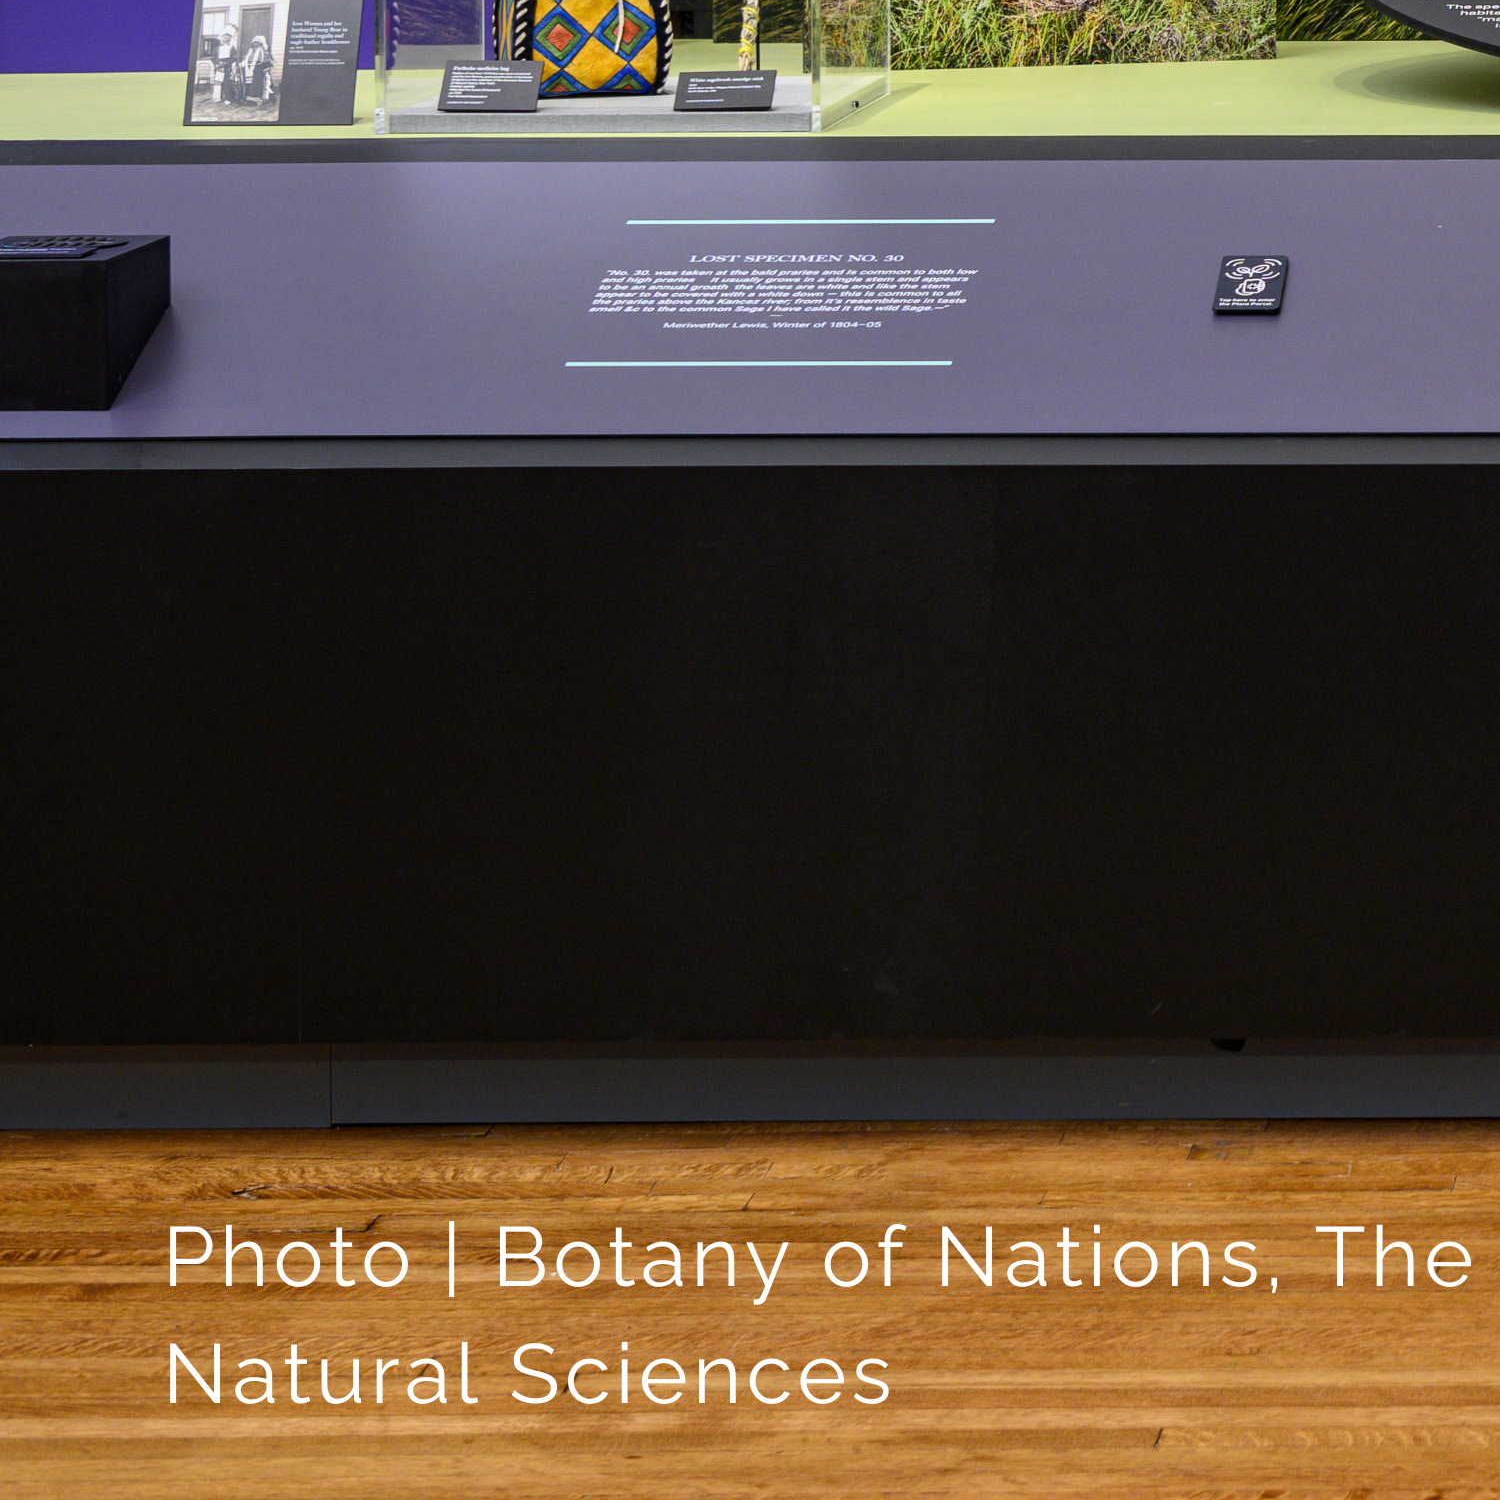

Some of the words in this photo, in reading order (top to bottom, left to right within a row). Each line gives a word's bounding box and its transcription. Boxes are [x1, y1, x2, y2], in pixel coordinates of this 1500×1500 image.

[744, 254, 843, 262] SPECIMEN
[847, 254, 878, 262] NO.
[883, 254, 904, 262] 30
